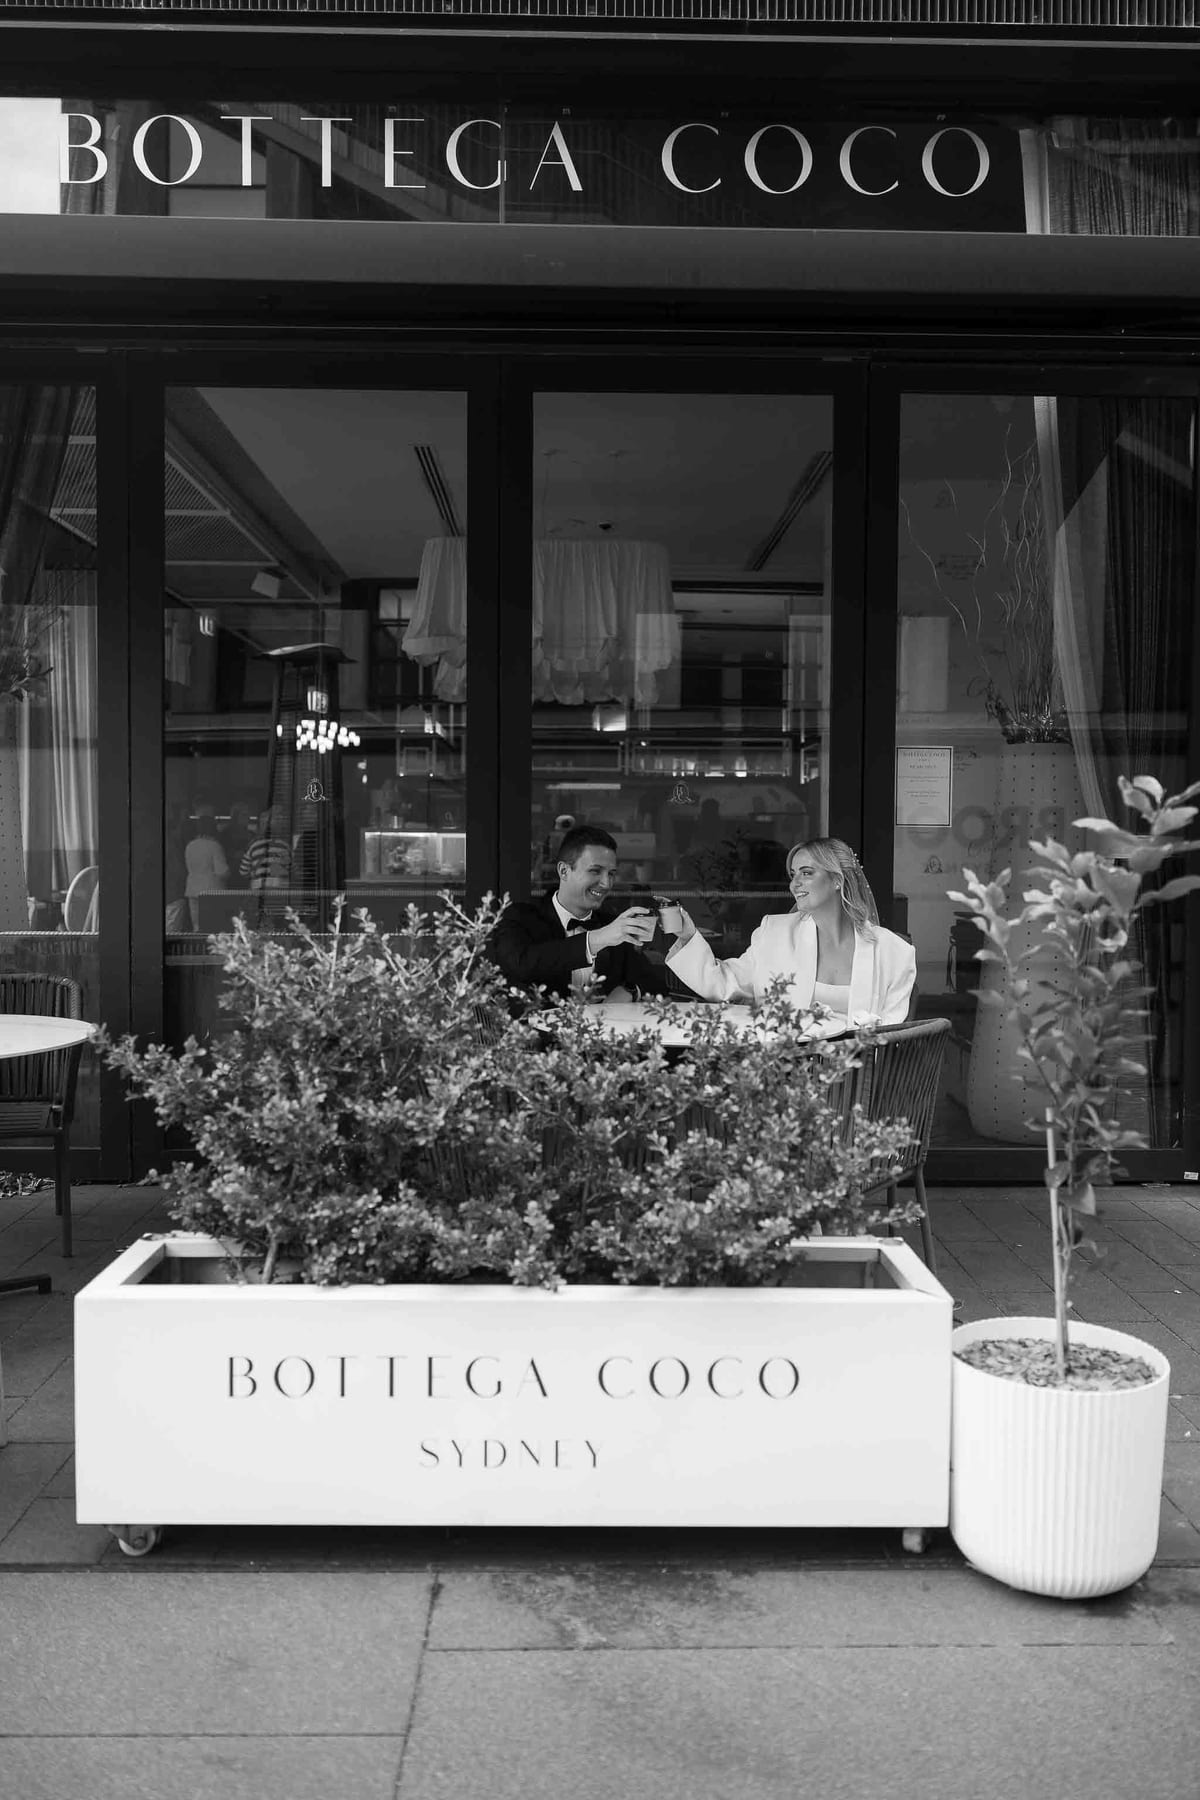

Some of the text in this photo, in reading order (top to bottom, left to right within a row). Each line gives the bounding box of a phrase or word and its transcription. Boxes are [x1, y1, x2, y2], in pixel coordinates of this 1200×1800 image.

[60, 112, 990, 196] BOTTEGA COCO
[227, 1355, 801, 1399] BOTTEGA COCO
[418, 1438, 603, 1469] SYDNEY
